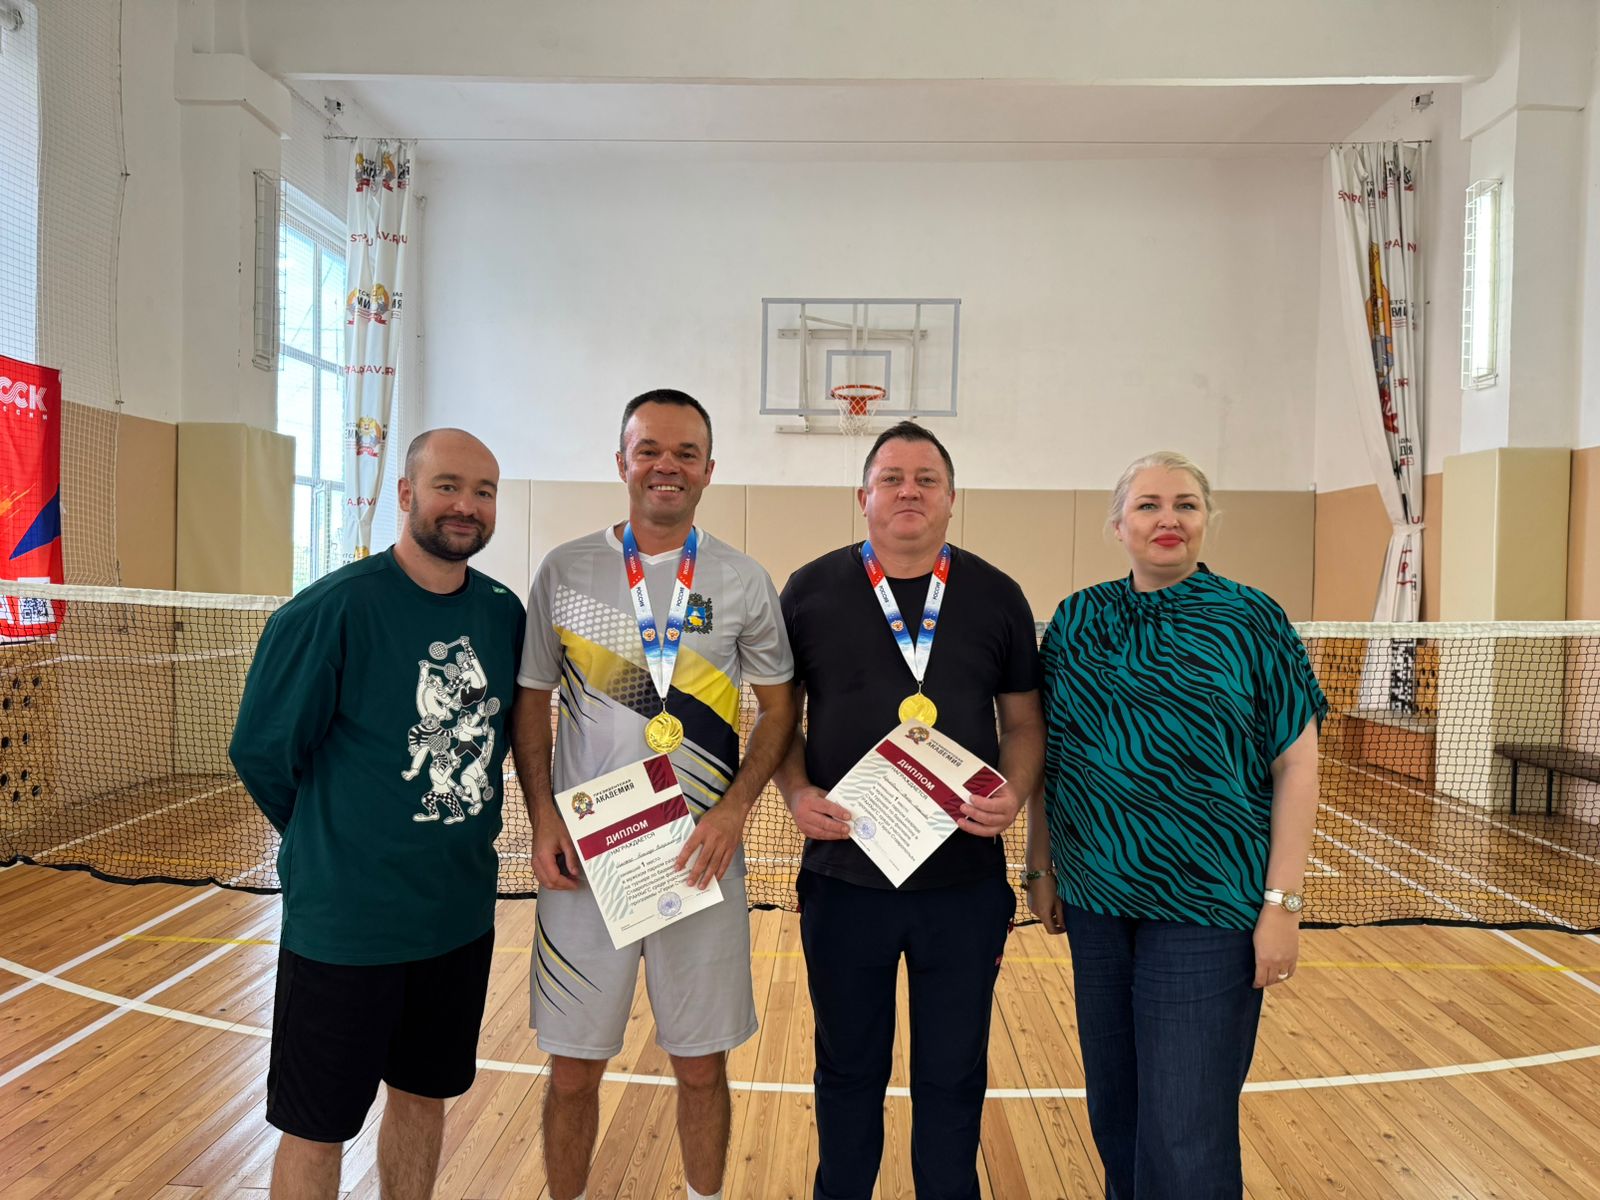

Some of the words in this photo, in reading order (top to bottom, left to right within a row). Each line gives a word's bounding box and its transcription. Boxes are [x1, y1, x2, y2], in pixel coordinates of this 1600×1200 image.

[924, 741, 962, 767] АКАДЕМИЯ
[889, 766, 929, 799] НАГРАЖДАЕТСЯ
[896, 758, 936, 791] ДИПЛОМ
[594, 782, 635, 804] АКАДЕМИЯ
[603, 819, 649, 845] ДИПЛОМ
[609, 831, 656, 855] НАГРАЖДАЕТСЯ
